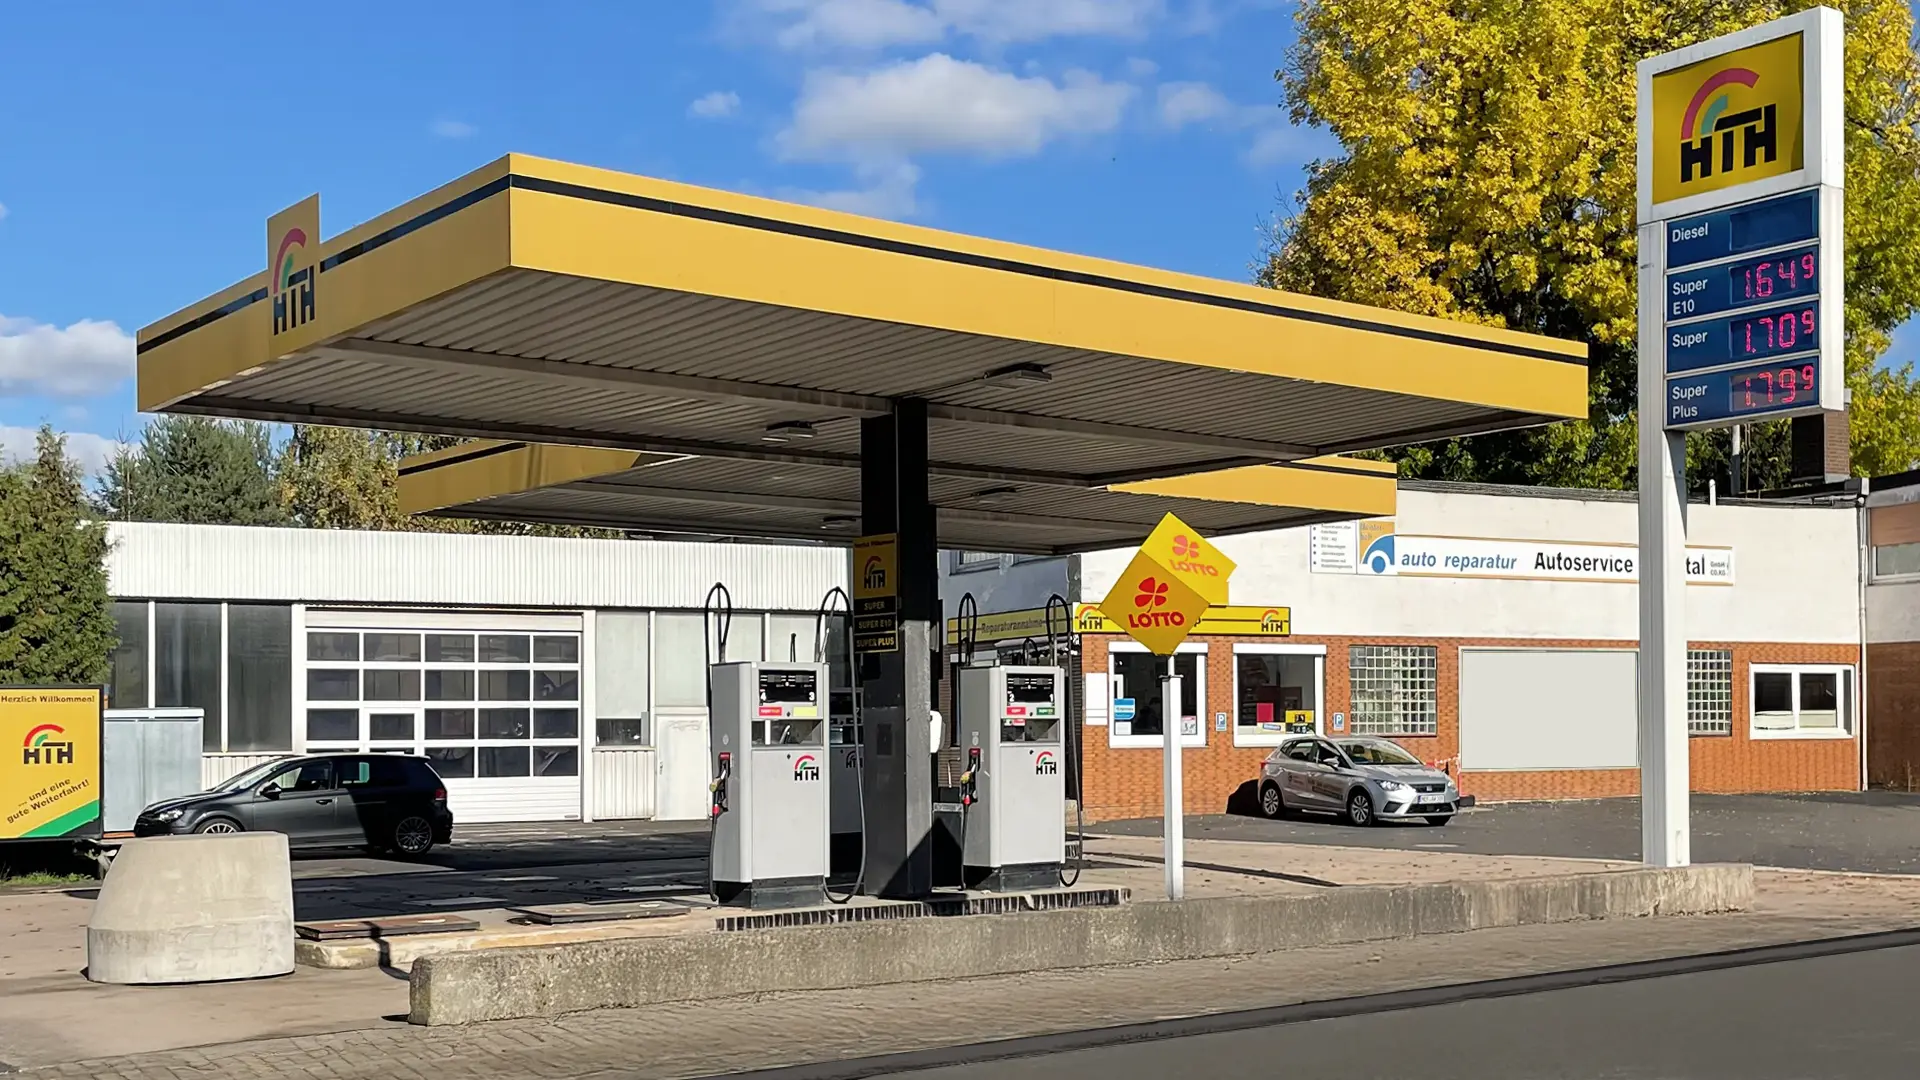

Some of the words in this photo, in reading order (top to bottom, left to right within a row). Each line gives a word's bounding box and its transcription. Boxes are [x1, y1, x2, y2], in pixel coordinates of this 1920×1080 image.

[1681, 103, 1777, 183] HTH
[1672, 222, 1708, 243] Diesel
[1672, 278, 1708, 296] Super
[273, 265, 315, 336] HTH
[1672, 299, 1695, 315] E10
[1672, 331, 1708, 349] Super
[1672, 384, 1708, 400] Super
[1672, 405, 1698, 419] Plus
[1168, 559, 1219, 577] LOTTO
[1401, 552, 1437, 567] auto
[1444, 553, 1518, 571] reparatur
[1534, 552, 1634, 573] Autoservice
[863, 569, 886, 589] HTH
[863, 601, 886, 611] SUPER
[858, 619, 879, 629] SUPER
[879, 618, 893, 628] E10
[1078, 616, 1103, 630] HTH
[1128, 611, 1185, 629] LOTTO
[1261, 620, 1283, 632] HTH
[856, 638, 877, 648] SUPER
[877, 636, 895, 647] PLUS
[1, 695, 37, 703] Herzlich
[39, 695, 95, 703] Willkommen!
[760, 691, 767, 701] 4
[808, 691, 815, 701] 3
[1009, 693, 1015, 702] 2
[1049, 693, 1054, 702] 1
[23, 742, 74, 764] HTH
[794, 766, 820, 781] HTH
[1036, 762, 1057, 775] HTH
[28, 788, 48, 801] und
[49, 778, 71, 792] eine
[7, 808, 30, 824] gute
[30, 779, 90, 811] Weiterfahrt!
